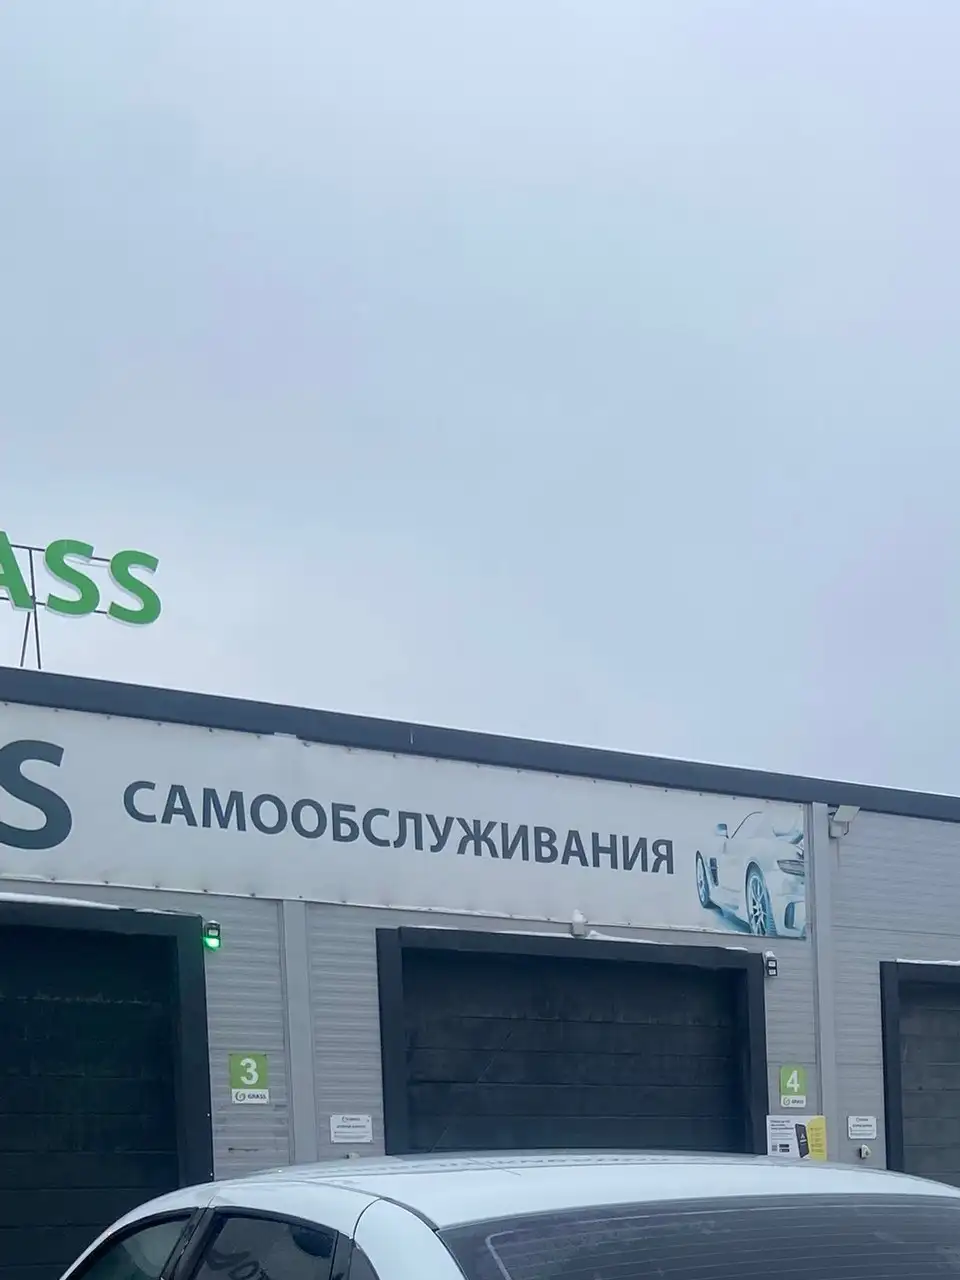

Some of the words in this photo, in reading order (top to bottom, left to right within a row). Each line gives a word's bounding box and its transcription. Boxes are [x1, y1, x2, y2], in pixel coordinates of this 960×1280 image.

[122, 779, 676, 876] САМООБСЛУЖИВАНИЯ
[239, 1057, 260, 1086] 3
[786, 1069, 800, 1093] 4
